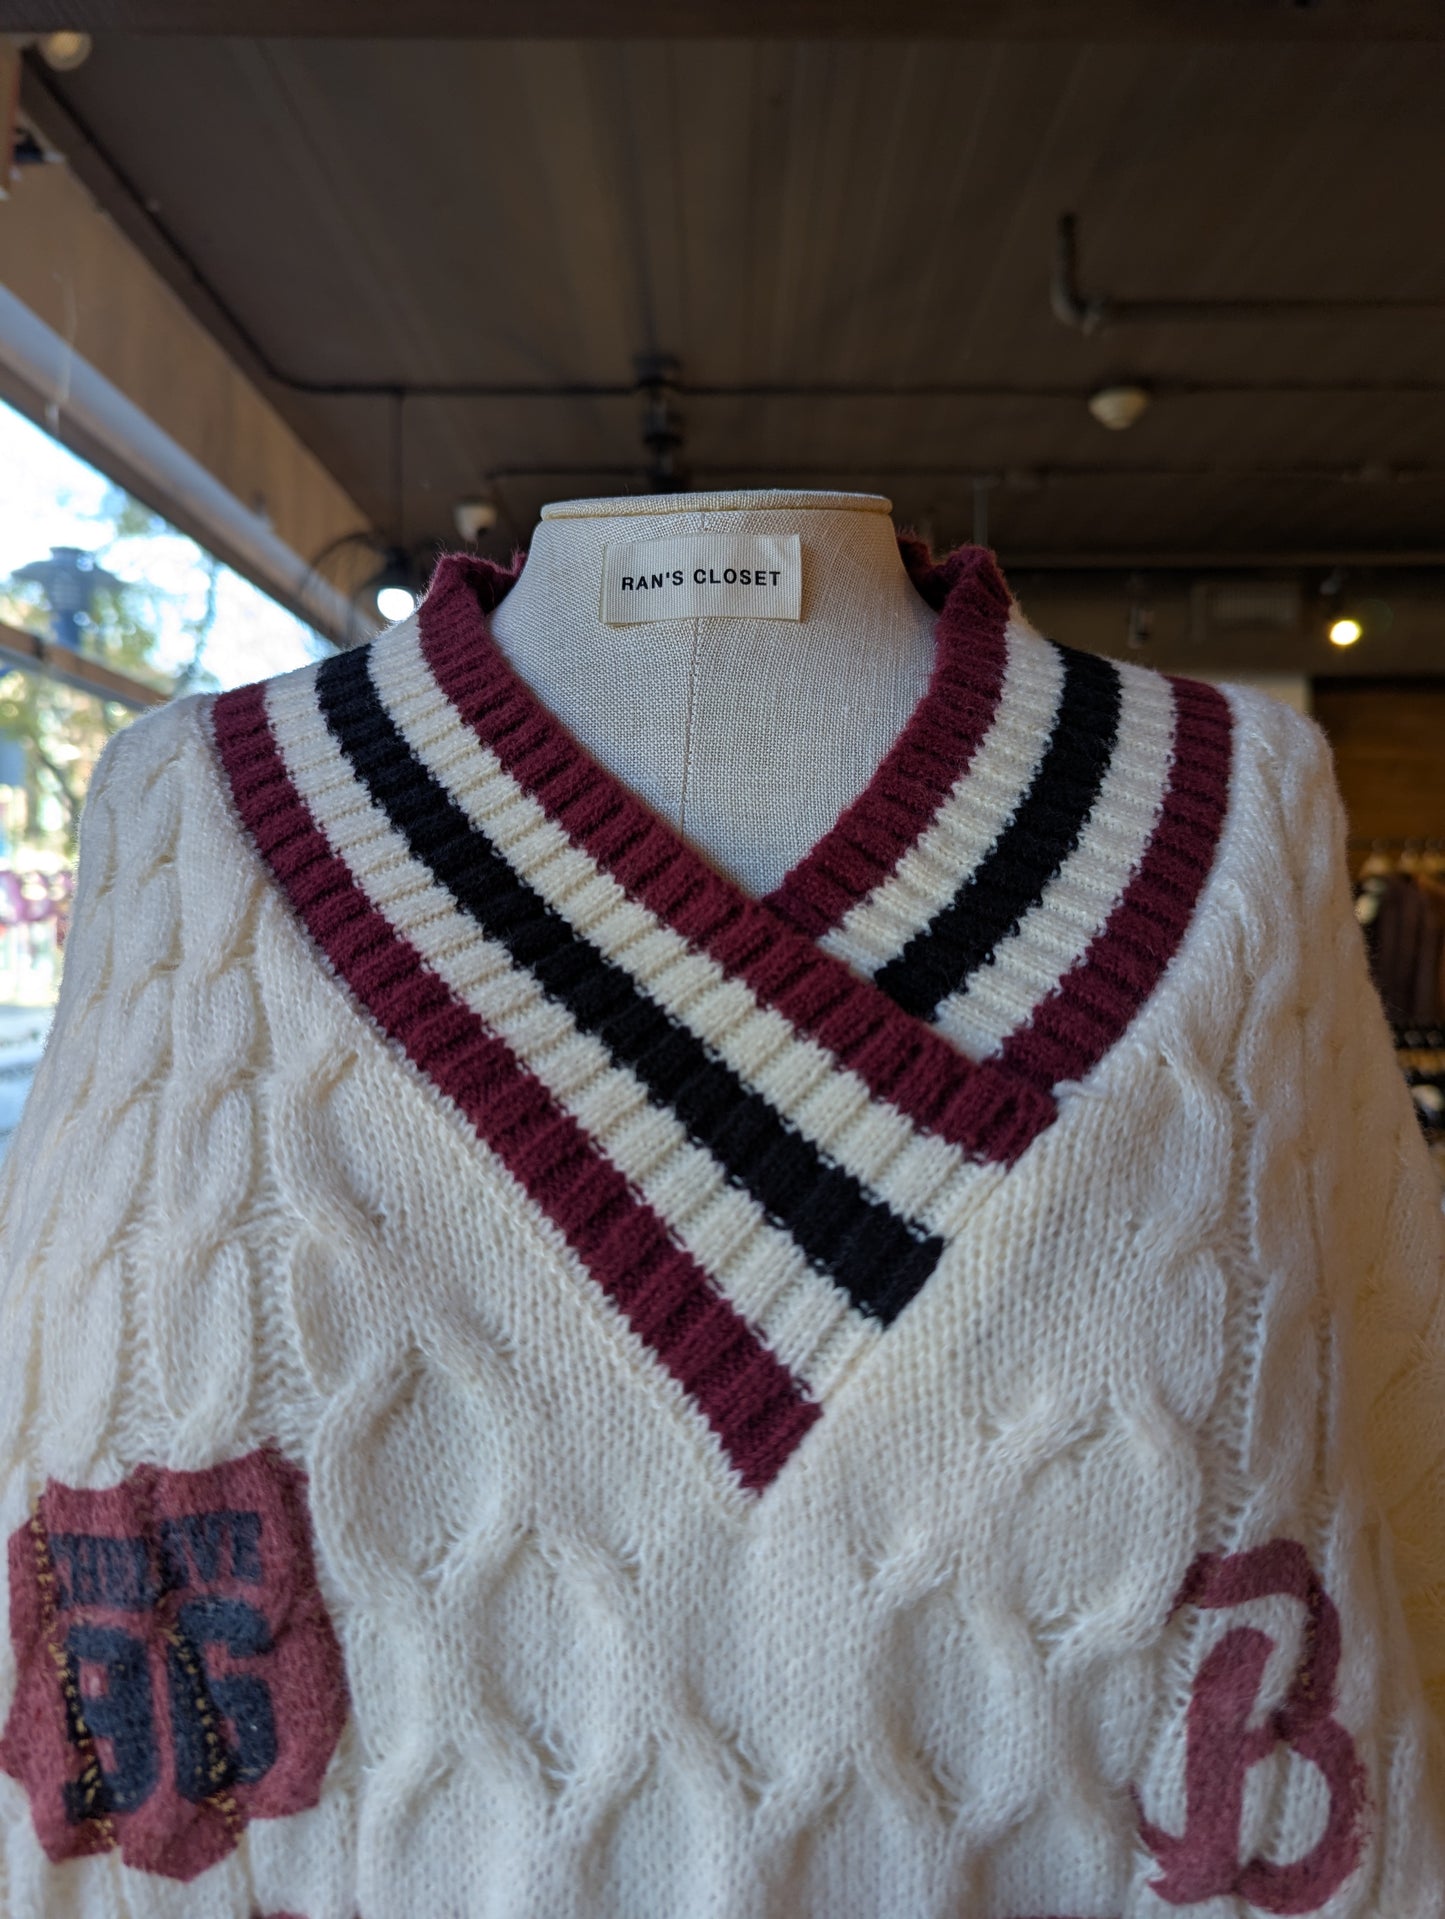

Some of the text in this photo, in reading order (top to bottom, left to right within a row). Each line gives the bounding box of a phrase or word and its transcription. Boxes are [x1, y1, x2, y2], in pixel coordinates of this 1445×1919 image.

[622, 568, 781, 590] RAN'S CLOSET
[64, 1595, 279, 1825] 96
[1130, 1538, 1368, 1915] B
